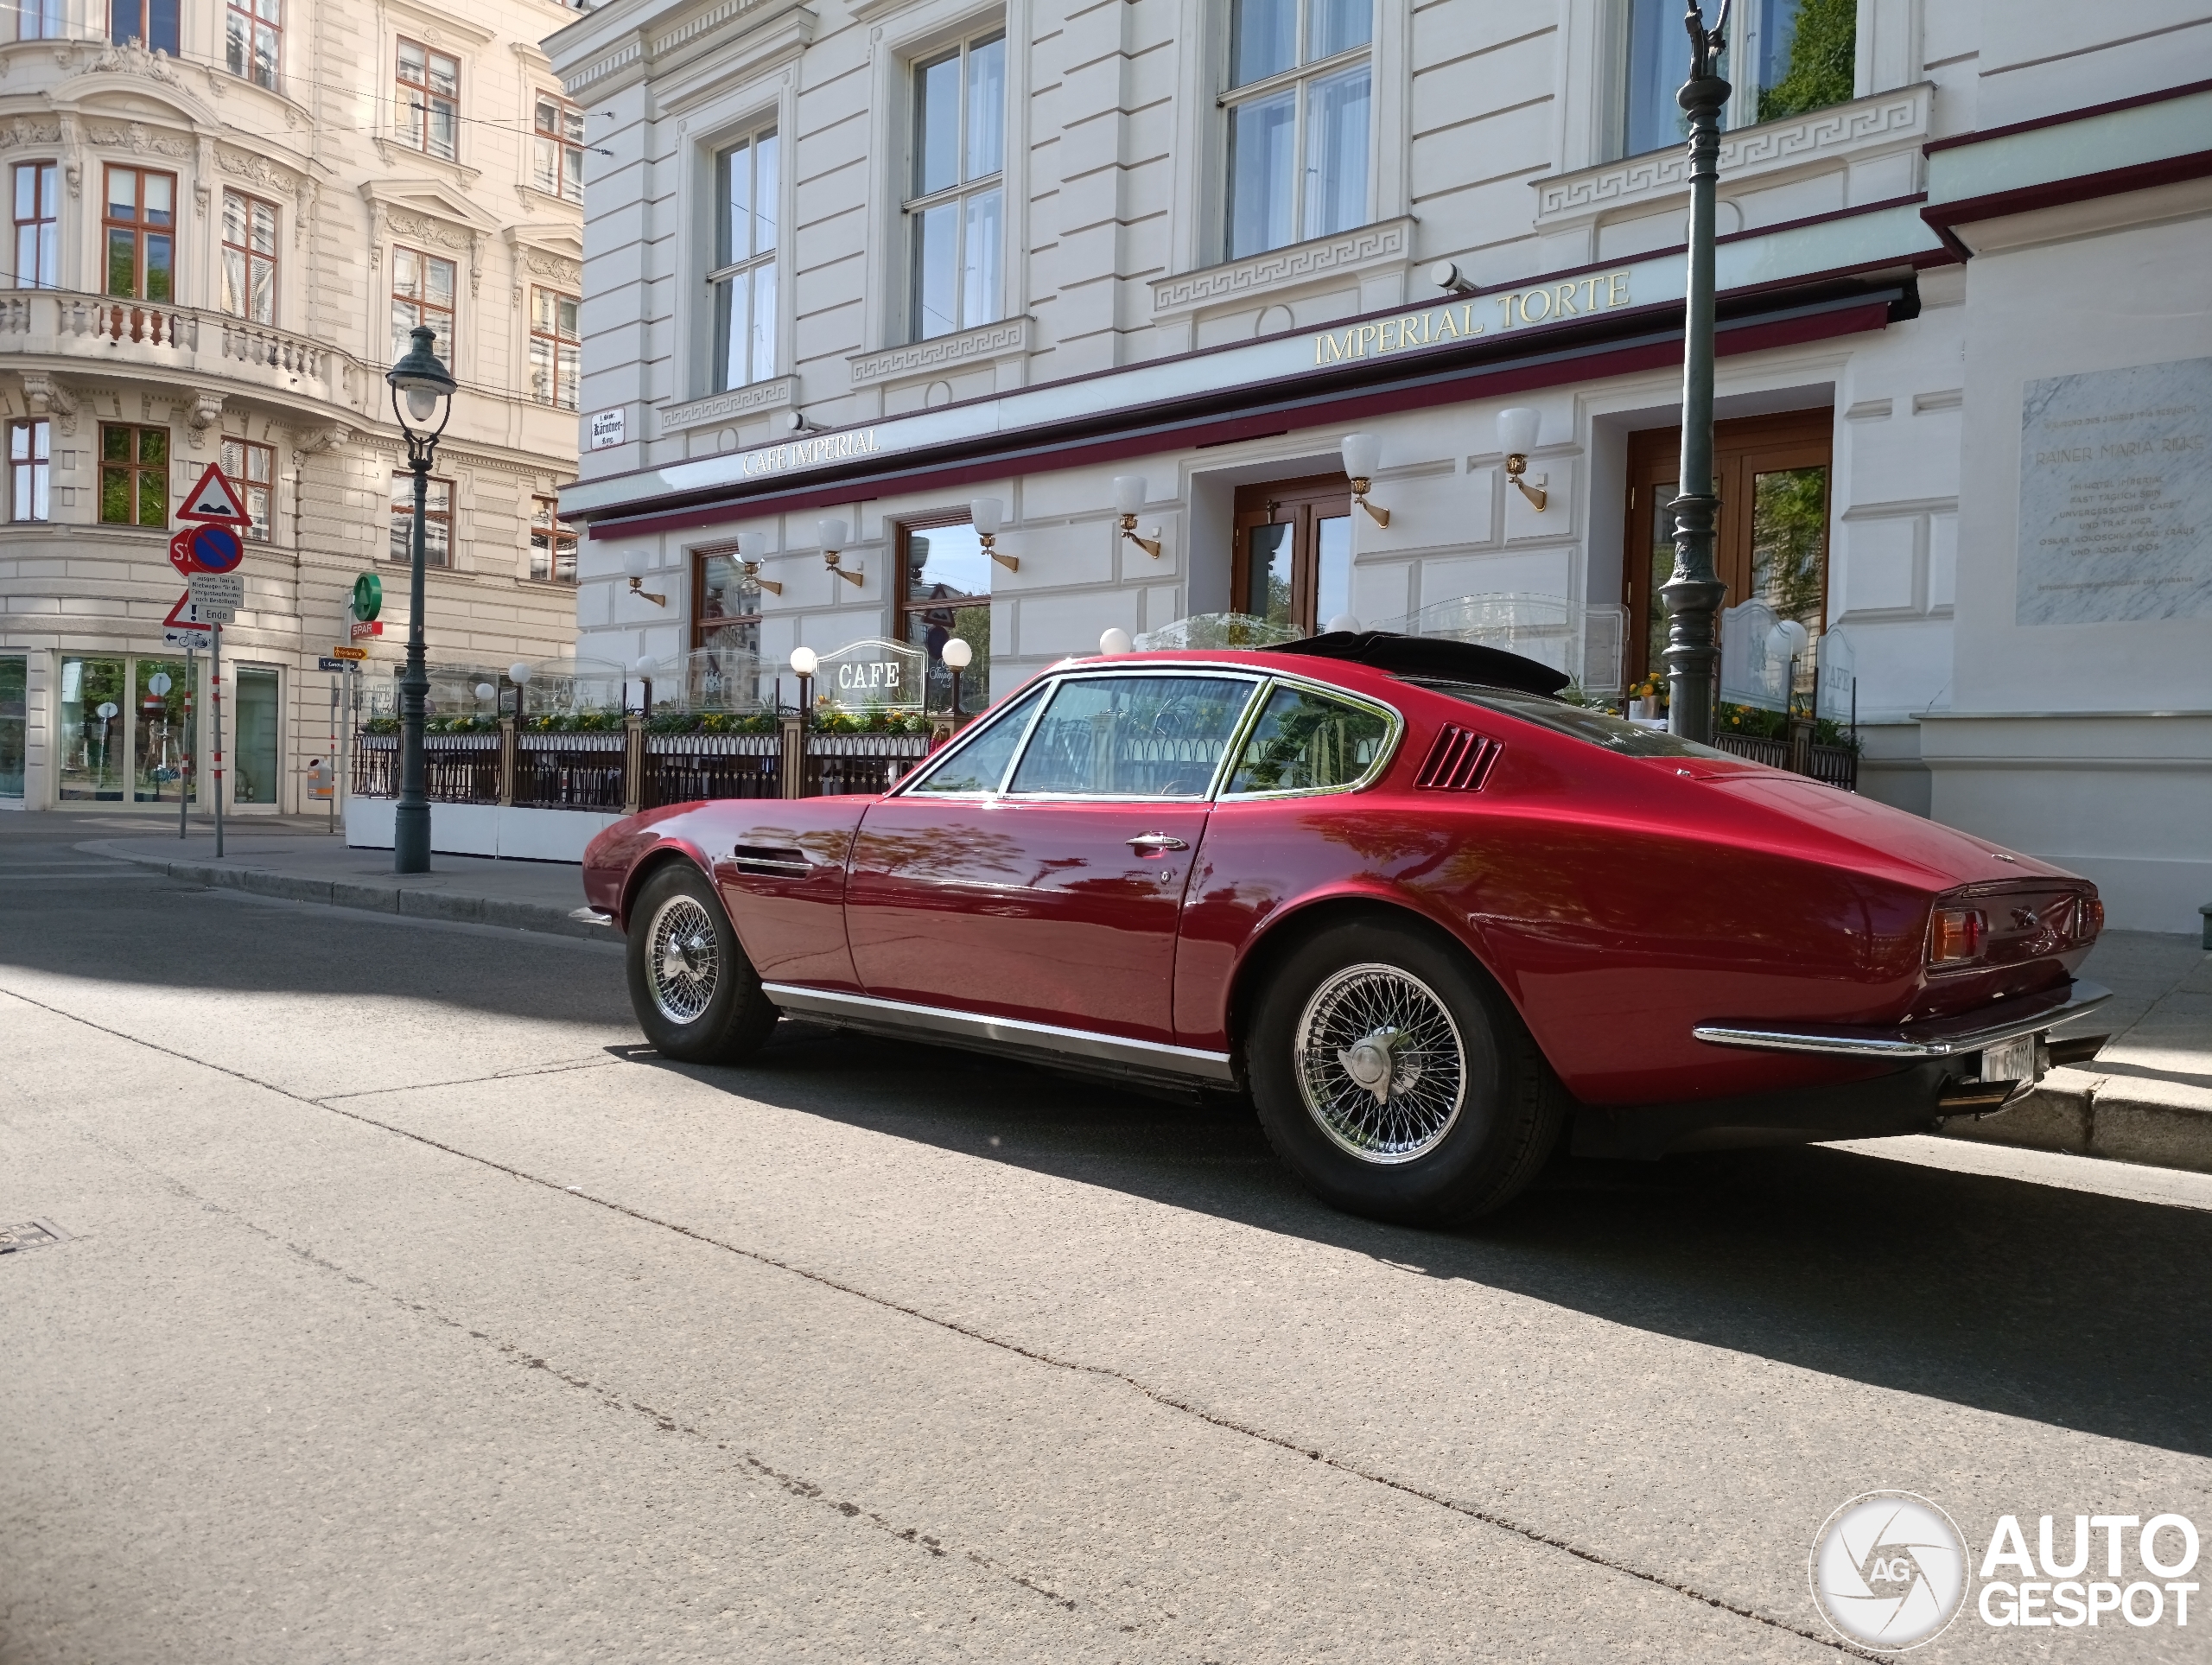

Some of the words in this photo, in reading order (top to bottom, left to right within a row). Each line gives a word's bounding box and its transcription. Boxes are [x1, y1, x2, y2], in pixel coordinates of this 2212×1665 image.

[1314, 304, 1484, 365] IMPERIAL
[1497, 271, 1630, 328] TORTE
[2102, 412, 2134, 423] JAHRES
[744, 443, 787, 475] CAFÉ
[791, 429, 880, 467] IMPERIAL
[2036, 447, 2093, 466] RAINER
[2101, 441, 2154, 460] MARIA
[2162, 435, 2204, 453] RILKE
[2084, 480, 2114, 490] HOTEL
[2118, 476, 2164, 487] IMPERIAL
[2070, 495, 2094, 504] FAST
[2139, 489, 2161, 499] SEIN
[2059, 504, 2145, 518] UNVERGESSLICHES
[2080, 521, 2099, 530] UND
[2102, 519, 2126, 528] TRAF
[2130, 517, 2152, 525] HIER
[2039, 537, 2070, 546] OSKAR
[2164, 526, 2196, 536] KRAUS
[2071, 548, 2090, 556] UND
[2096, 545, 2129, 555] ADOLF
[2132, 543, 2159, 552] LOOS
[209, 597, 238, 606] Bestellung
[207, 610, 227, 620] Ende
[353, 624, 372, 635] SPAR
[839, 662, 899, 690] CAFE
